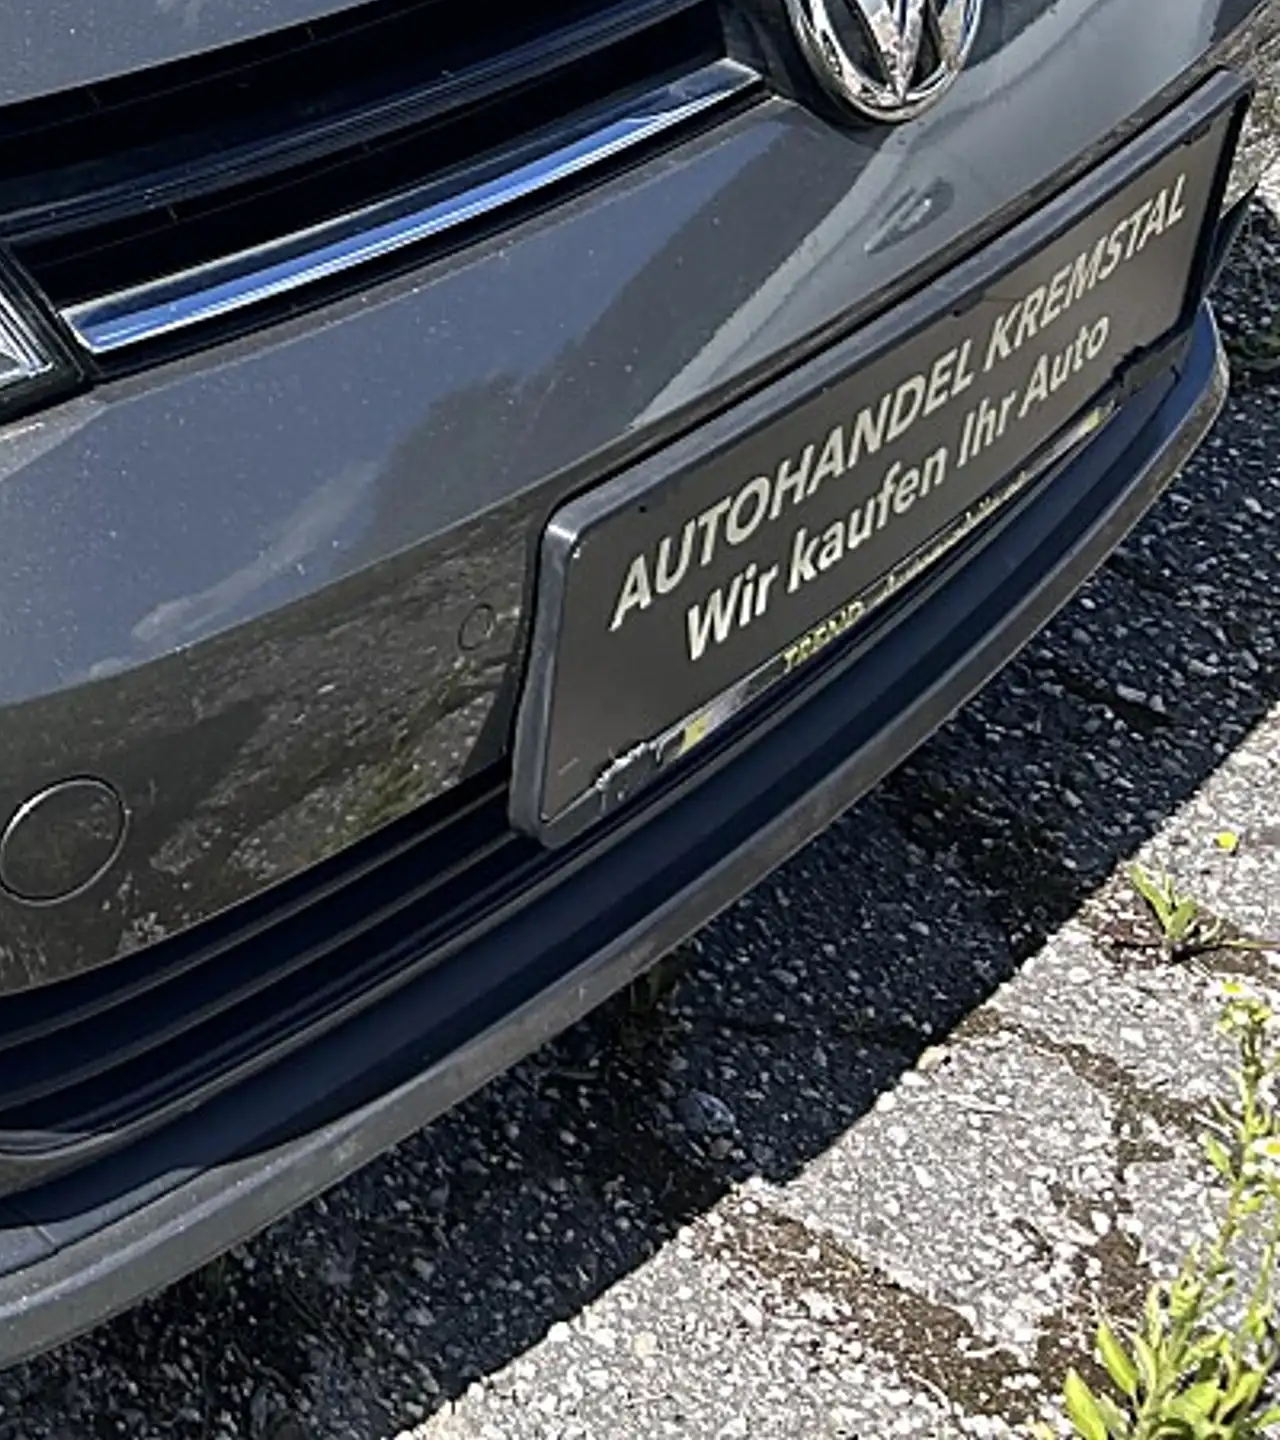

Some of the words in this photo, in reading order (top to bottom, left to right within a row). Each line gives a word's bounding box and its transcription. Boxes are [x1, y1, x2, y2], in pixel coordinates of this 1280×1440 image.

[608, 338, 974, 632] AUTOHANDEL
[982, 172, 1186, 373] KREMSTAL
[687, 562, 779, 661] Wir
[787, 445, 948, 594] kaufen
[956, 389, 1017, 468] Ihr
[1017, 315, 1110, 419] Auto
